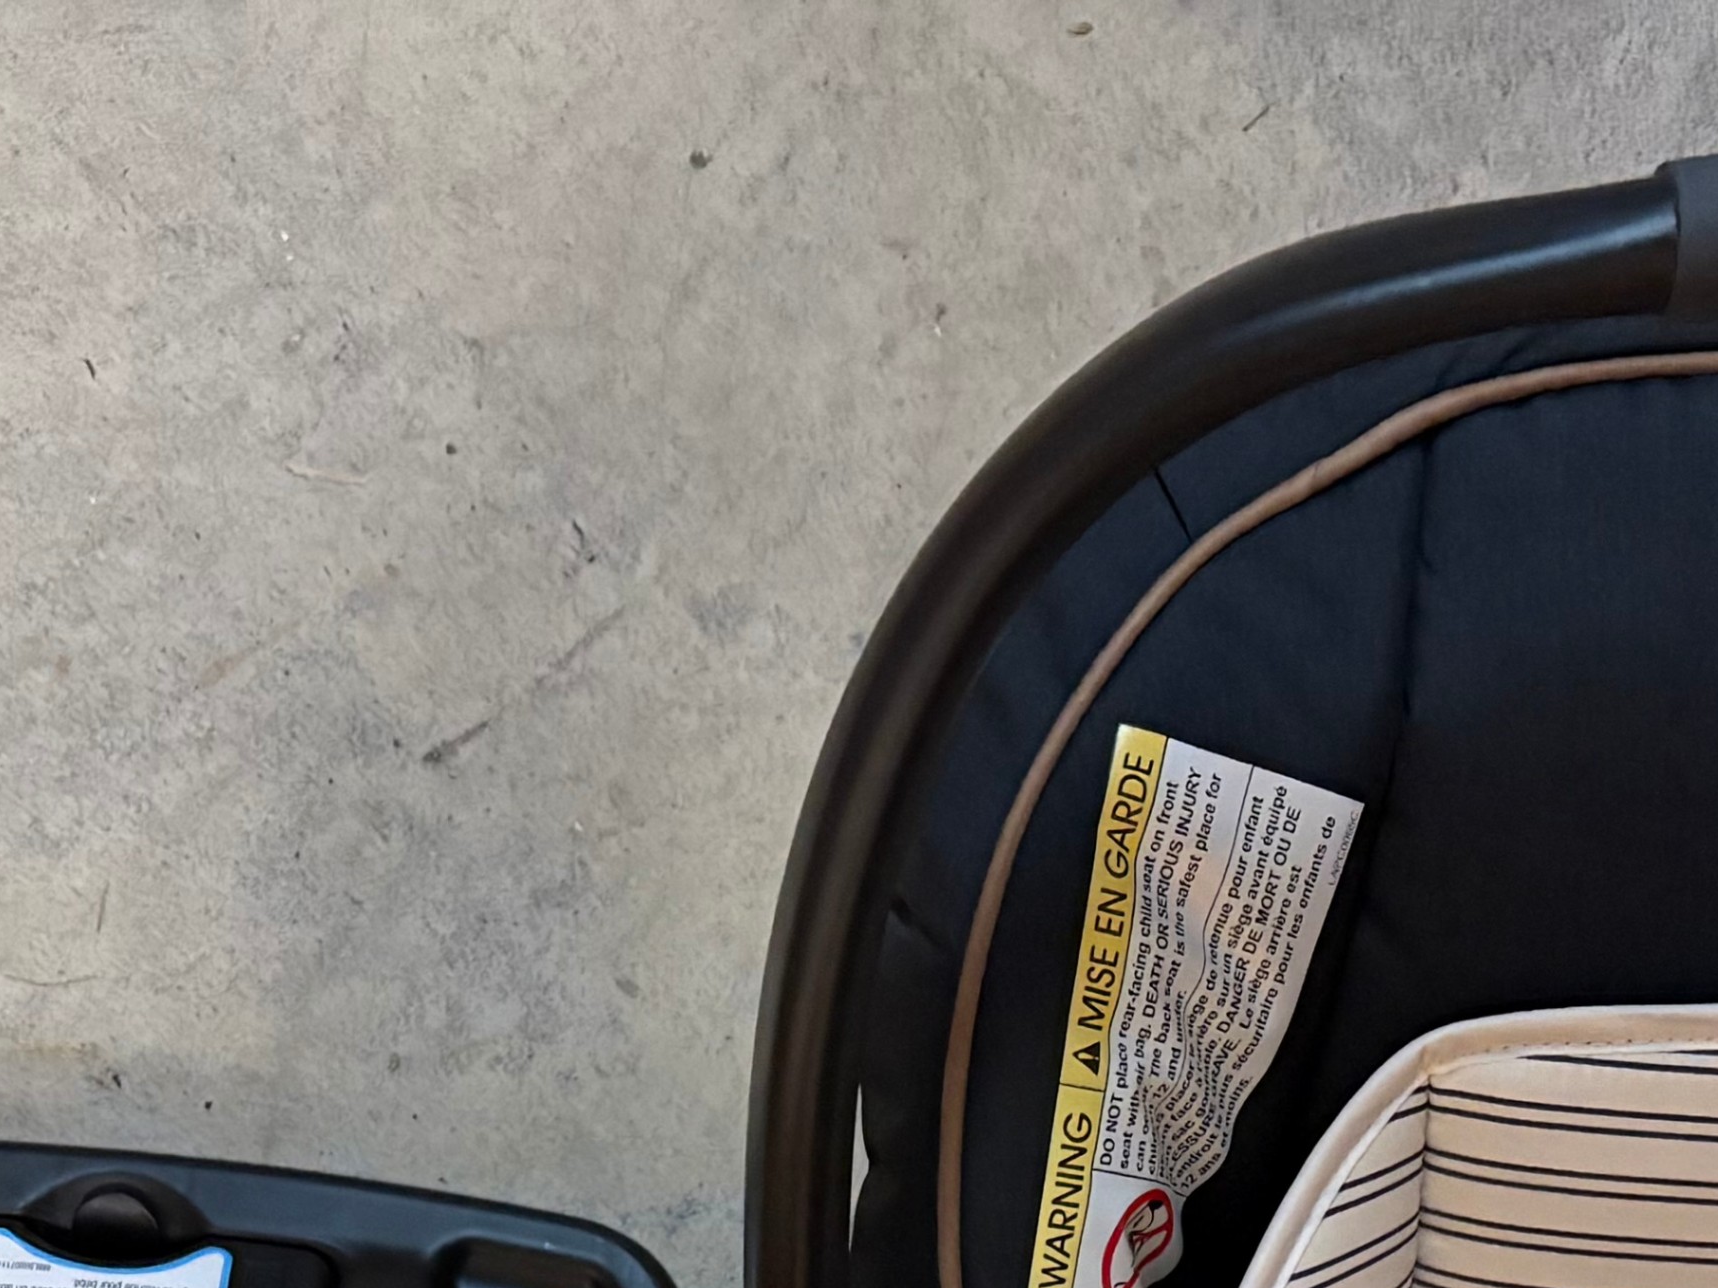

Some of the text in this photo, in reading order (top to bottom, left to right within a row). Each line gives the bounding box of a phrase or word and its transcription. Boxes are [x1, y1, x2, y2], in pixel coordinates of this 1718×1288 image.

[1173, 766, 1205, 838] INJURY
[1205, 772, 1224, 799] for
[1194, 802, 1219, 852] place
[1238, 794, 1264, 853] enfant
[1281, 805, 1301, 834] DE
[1318, 814, 1337, 840] de
[1223, 900, 1257, 951] siège
[1243, 848, 1270, 900] avant
[1258, 783, 1290, 847] équipé
[1271, 836, 1293, 868] OU
[1077, 751, 1152, 1033] MISE EN GARDE
[1154, 838, 1184, 919] SERIOUS
[1170, 852, 1202, 909] safest
[1225, 854, 1252, 900] pour
[1253, 868, 1284, 926] MORT
[1295, 841, 1328, 910] enfants
[1153, 920, 1172, 950] OR
[1173, 939, 1187, 956] is
[1238, 864, 1303, 1030] Le siège arrière est
[1242, 926, 1263, 955] DE
[1286, 911, 1305, 939] les
[1098, 779, 1180, 1166] DO NOT place rear-facing child seat on front
[1139, 952, 1168, 1019] DEATH
[1273, 941, 1298, 984] pour
[1215, 956, 1253, 1035] DANGER
[1132, 1021, 1153, 1059] bag.
[1155, 1001, 1173, 1044] back
[1147, 1047, 1164, 1077] The
[1164, 1047, 1181, 1081] and
